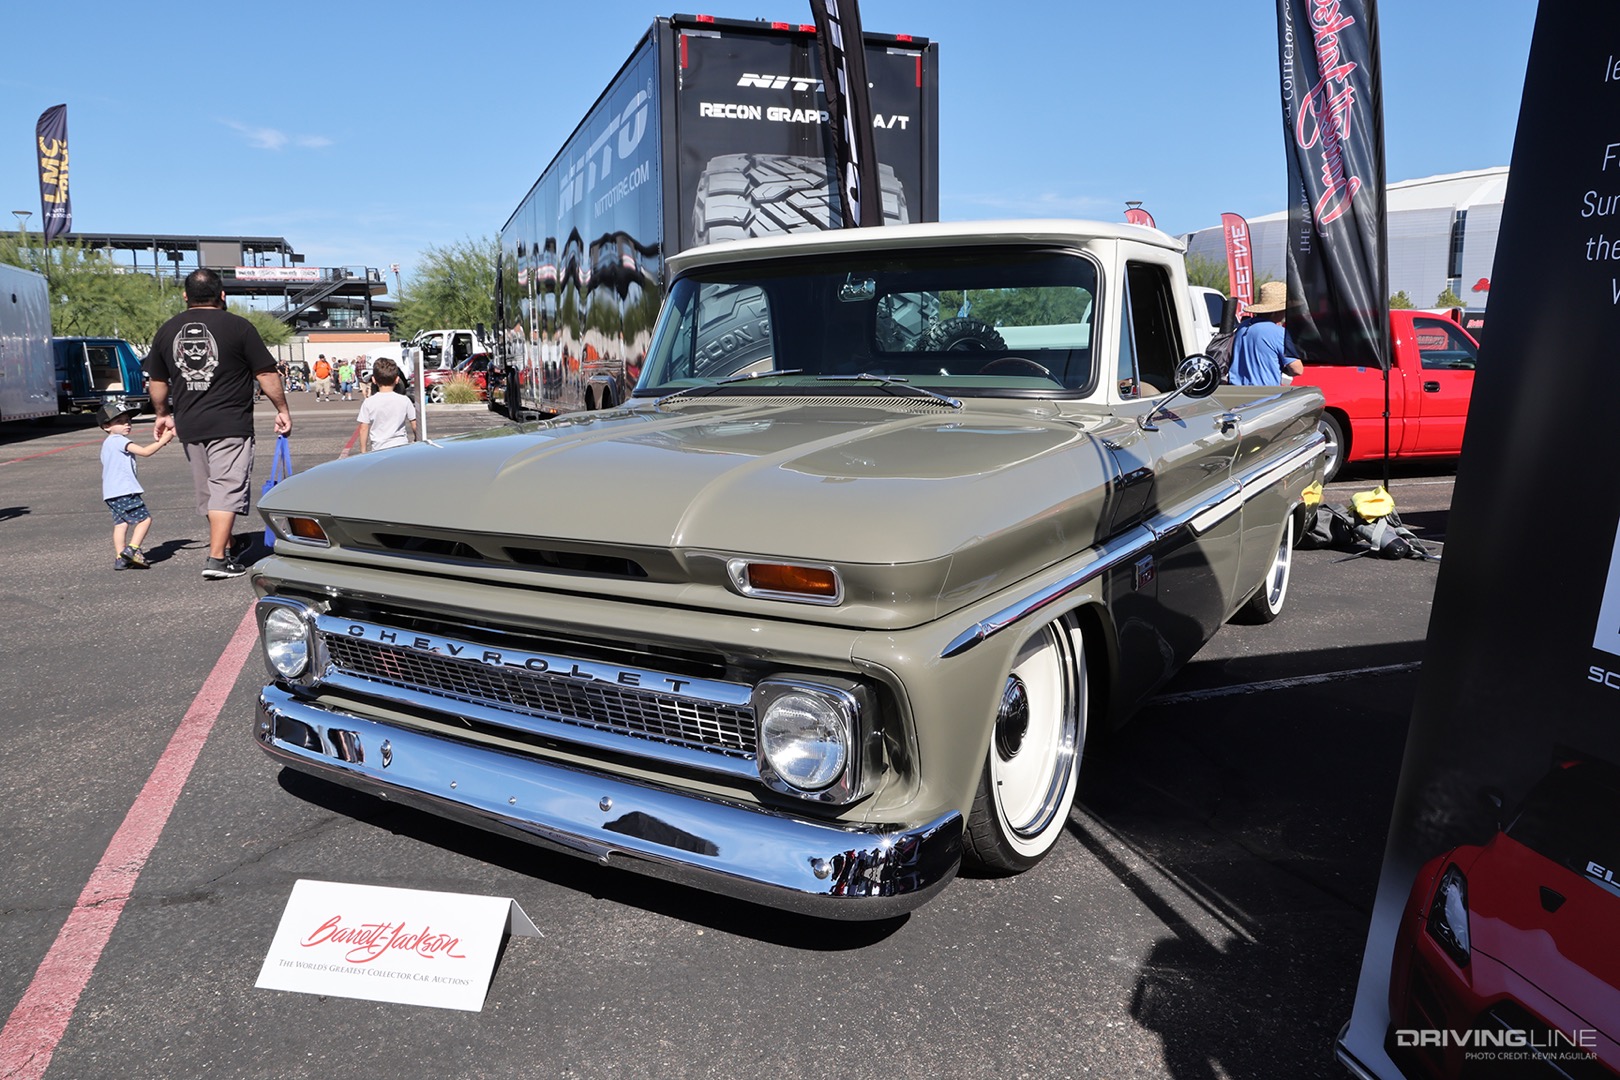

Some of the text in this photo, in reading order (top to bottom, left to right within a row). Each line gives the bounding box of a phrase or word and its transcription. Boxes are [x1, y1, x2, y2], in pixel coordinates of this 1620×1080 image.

[700, 102, 909, 130] RECON GRAPP A/T
[39, 136, 61, 203] LMC
[594, 160, 650, 219] NITTOTIRE.COM
[348, 624, 691, 692] CHEVROLET
[300, 915, 466, 964] Barrett-Jackson
[279, 959, 294, 968] THE
[295, 960, 328, 972] WORLD'S
[329, 963, 366, 976] GREATEST
[367, 967, 412, 980] COLLECTOR
[412, 973, 430, 982] CAR
